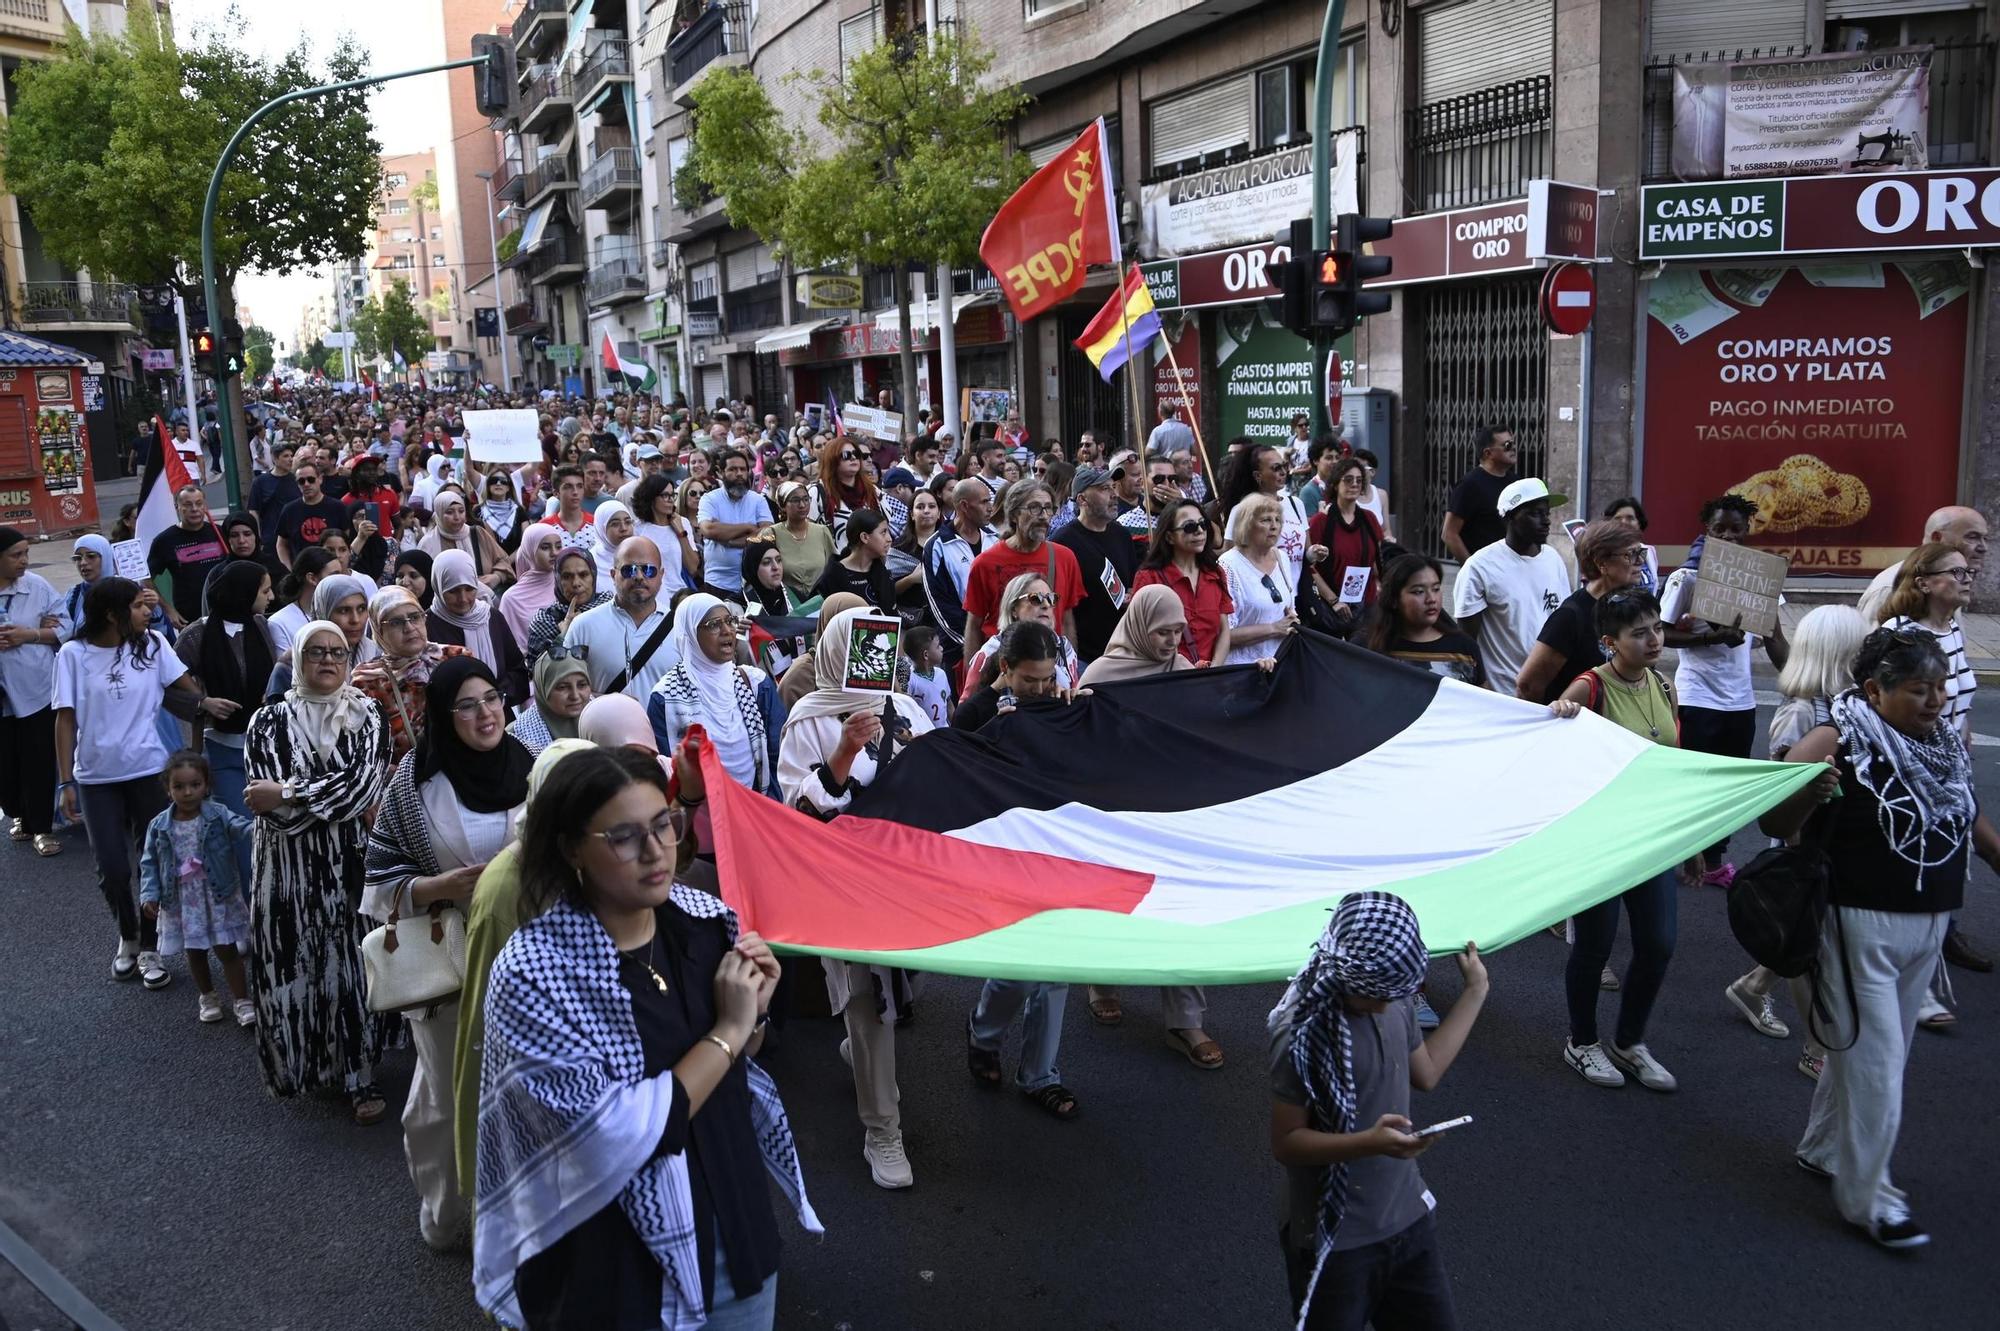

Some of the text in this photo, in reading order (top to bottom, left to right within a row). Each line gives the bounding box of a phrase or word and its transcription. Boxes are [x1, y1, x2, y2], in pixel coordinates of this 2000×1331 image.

[1744, 54, 1922, 80] ACADEMIA PORCUNA
[1731, 83, 1756, 92] corte
[1757, 83, 1764, 92] y
[1822, 75, 1855, 86] diseño
[1856, 75, 1862, 85] y
[1864, 72, 1893, 83] moda
[1731, 94, 1755, 103] historia
[1765, 92, 1772, 100] la
[1826, 88, 1859, 98] patronaje
[1744, 100, 1776, 110] bordados
[1782, 100, 1803, 108] mano
[1768, 112, 1805, 123] Titulación
[1806, 111, 1830, 121] oficial
[1877, 107, 1885, 115] la
[1759, 123, 1799, 133] Prestigiosa
[1800, 121, 1819, 130] Casa
[1731, 143, 1767, 152] impartido
[1768, 142, 1781, 151] por
[1792, 139, 1828, 150] profesora
[1730, 164, 1742, 172] Tel.
[1744, 160, 1788, 171] 658884289
[1794, 157, 1839, 168] 659767393
[1177, 150, 1314, 203] ACADEMIA PORCUN
[1170, 208, 1188, 221] corte
[1271, 183, 1299, 200] moda
[1656, 194, 1766, 219] CASA DE
[1455, 213, 1528, 241] COMPRO
[1647, 216, 1774, 243] EMPEÑOS
[1472, 238, 1510, 260] ORO
[1144, 269, 1174, 286] ASA DE
[1149, 284, 1177, 301] PEÑOS
[1671, 322, 1690, 341] 100
[1717, 336, 1892, 359] COMPRAMOS
[1158, 368, 1166, 378] EL
[1231, 363, 1274, 381] ¿GASTOS
[1720, 361, 1886, 383] ORO Y PLATA
[1155, 382, 1169, 393] ORO
[1227, 381, 1275, 395] FINANCIA
[1276, 381, 1299, 395] CON
[1247, 407, 1274, 419] HASTA
[1275, 408, 1281, 419] 3
[1709, 398, 1894, 416] PAGO INMEDIATO
[1244, 423, 1292, 437] RECUPERAR
[1695, 420, 1908, 440] TASACIÓN GRATUITA
[1703, 558, 1778, 594] PALESTINE
[931, 703, 941, 721] 2
